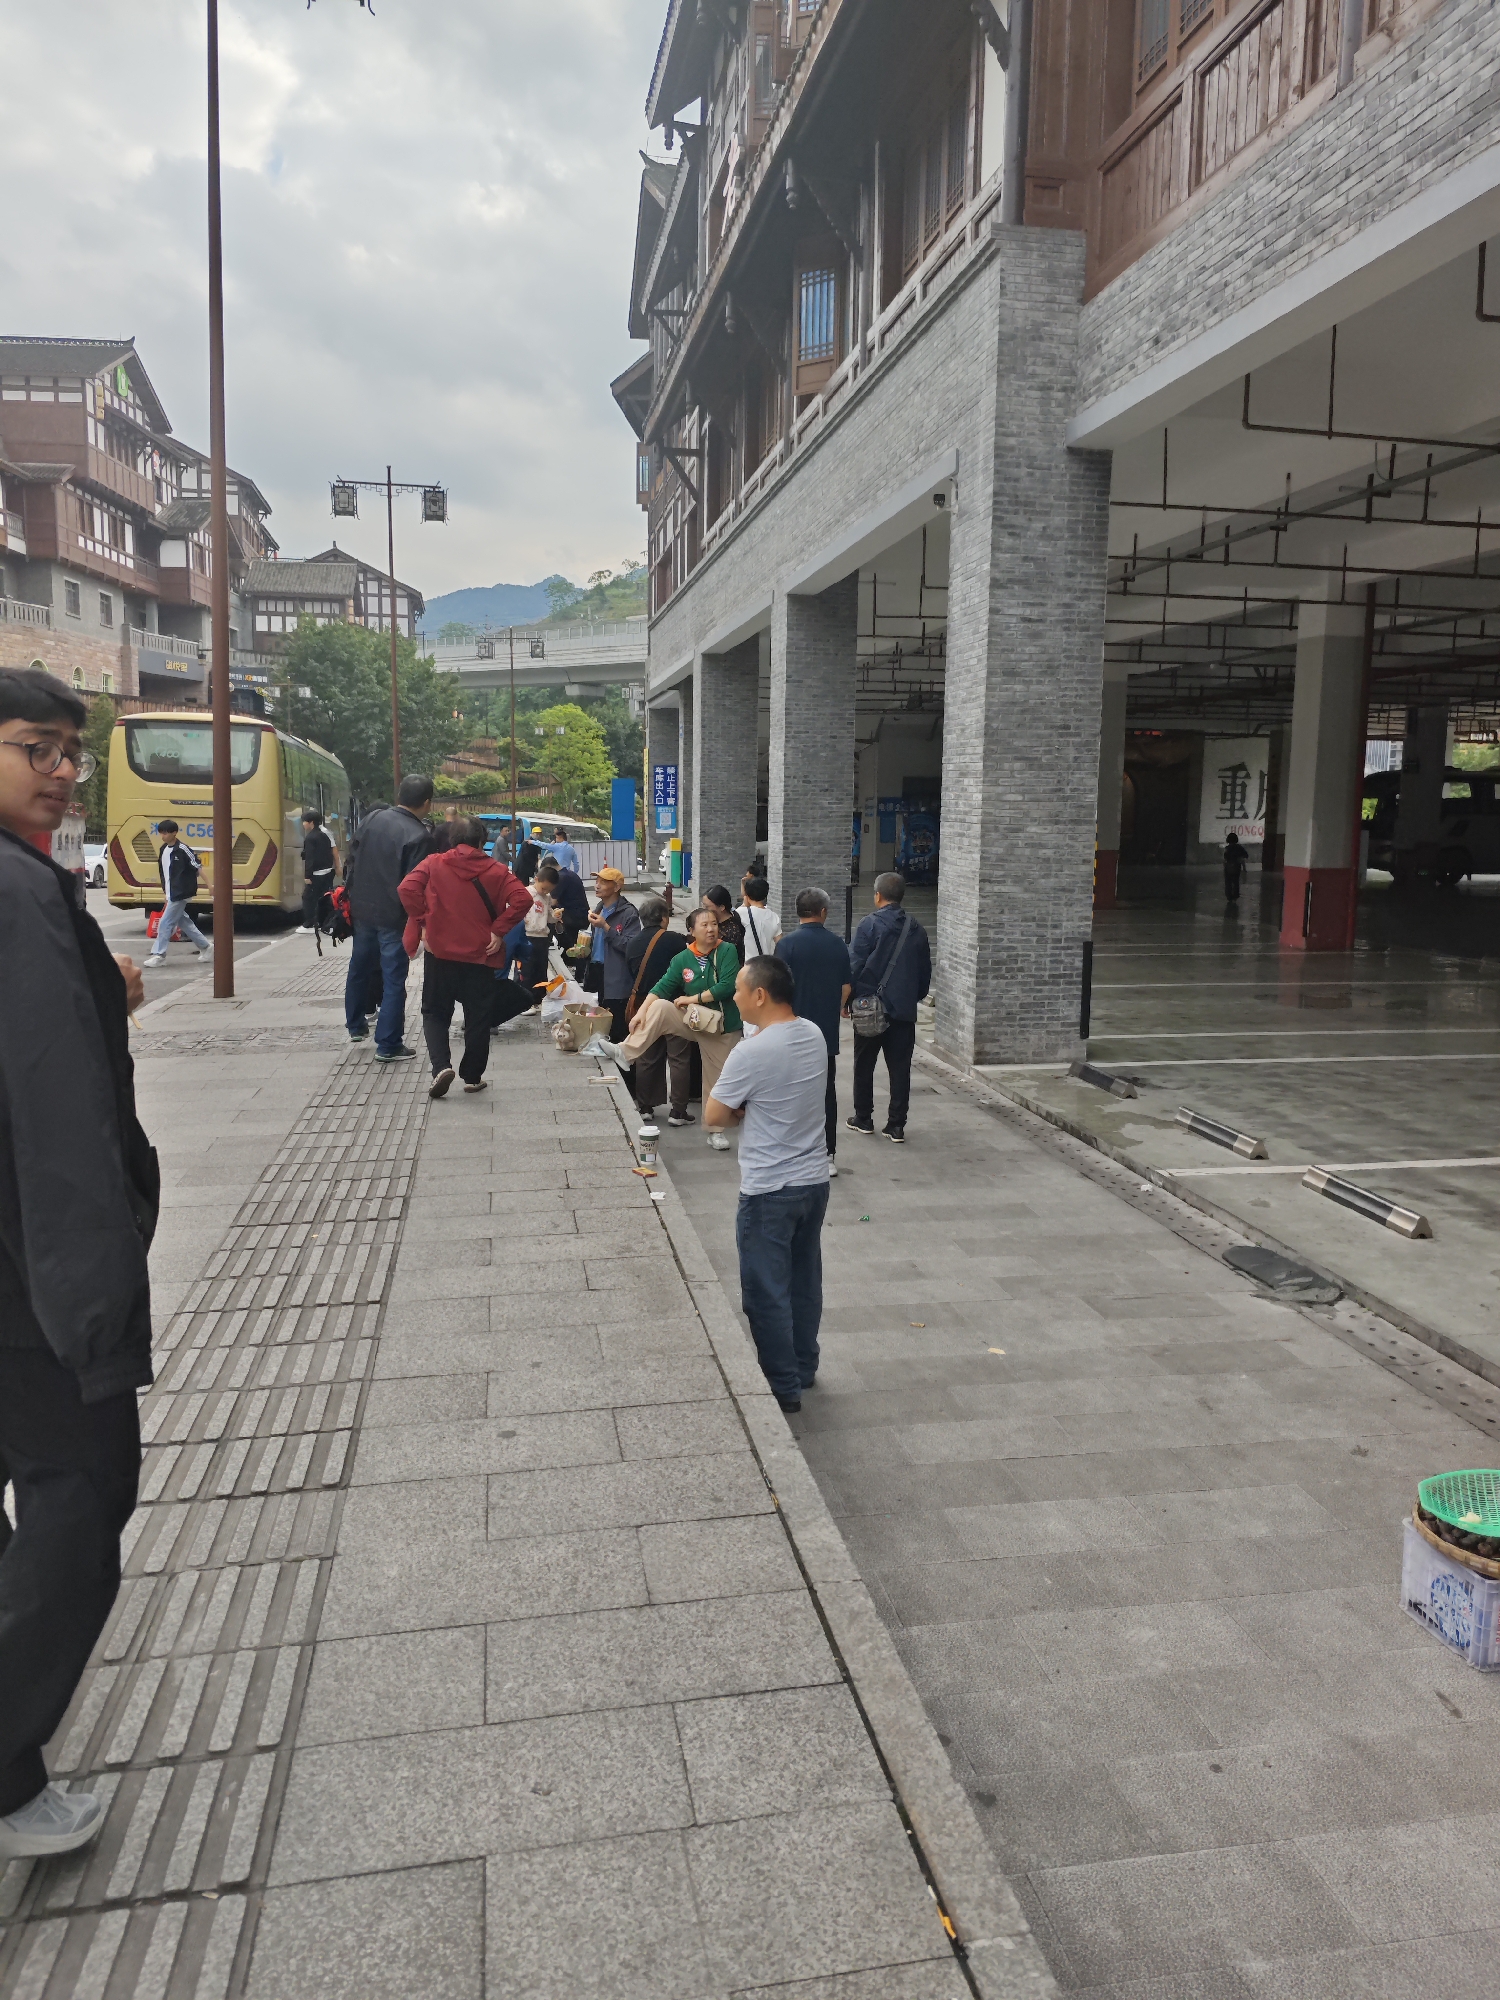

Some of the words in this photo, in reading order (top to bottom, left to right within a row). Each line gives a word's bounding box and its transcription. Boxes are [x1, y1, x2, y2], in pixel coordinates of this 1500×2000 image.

[655, 766, 664, 804] 车库出入口
[667, 766, 675, 805] 禁止上下客
